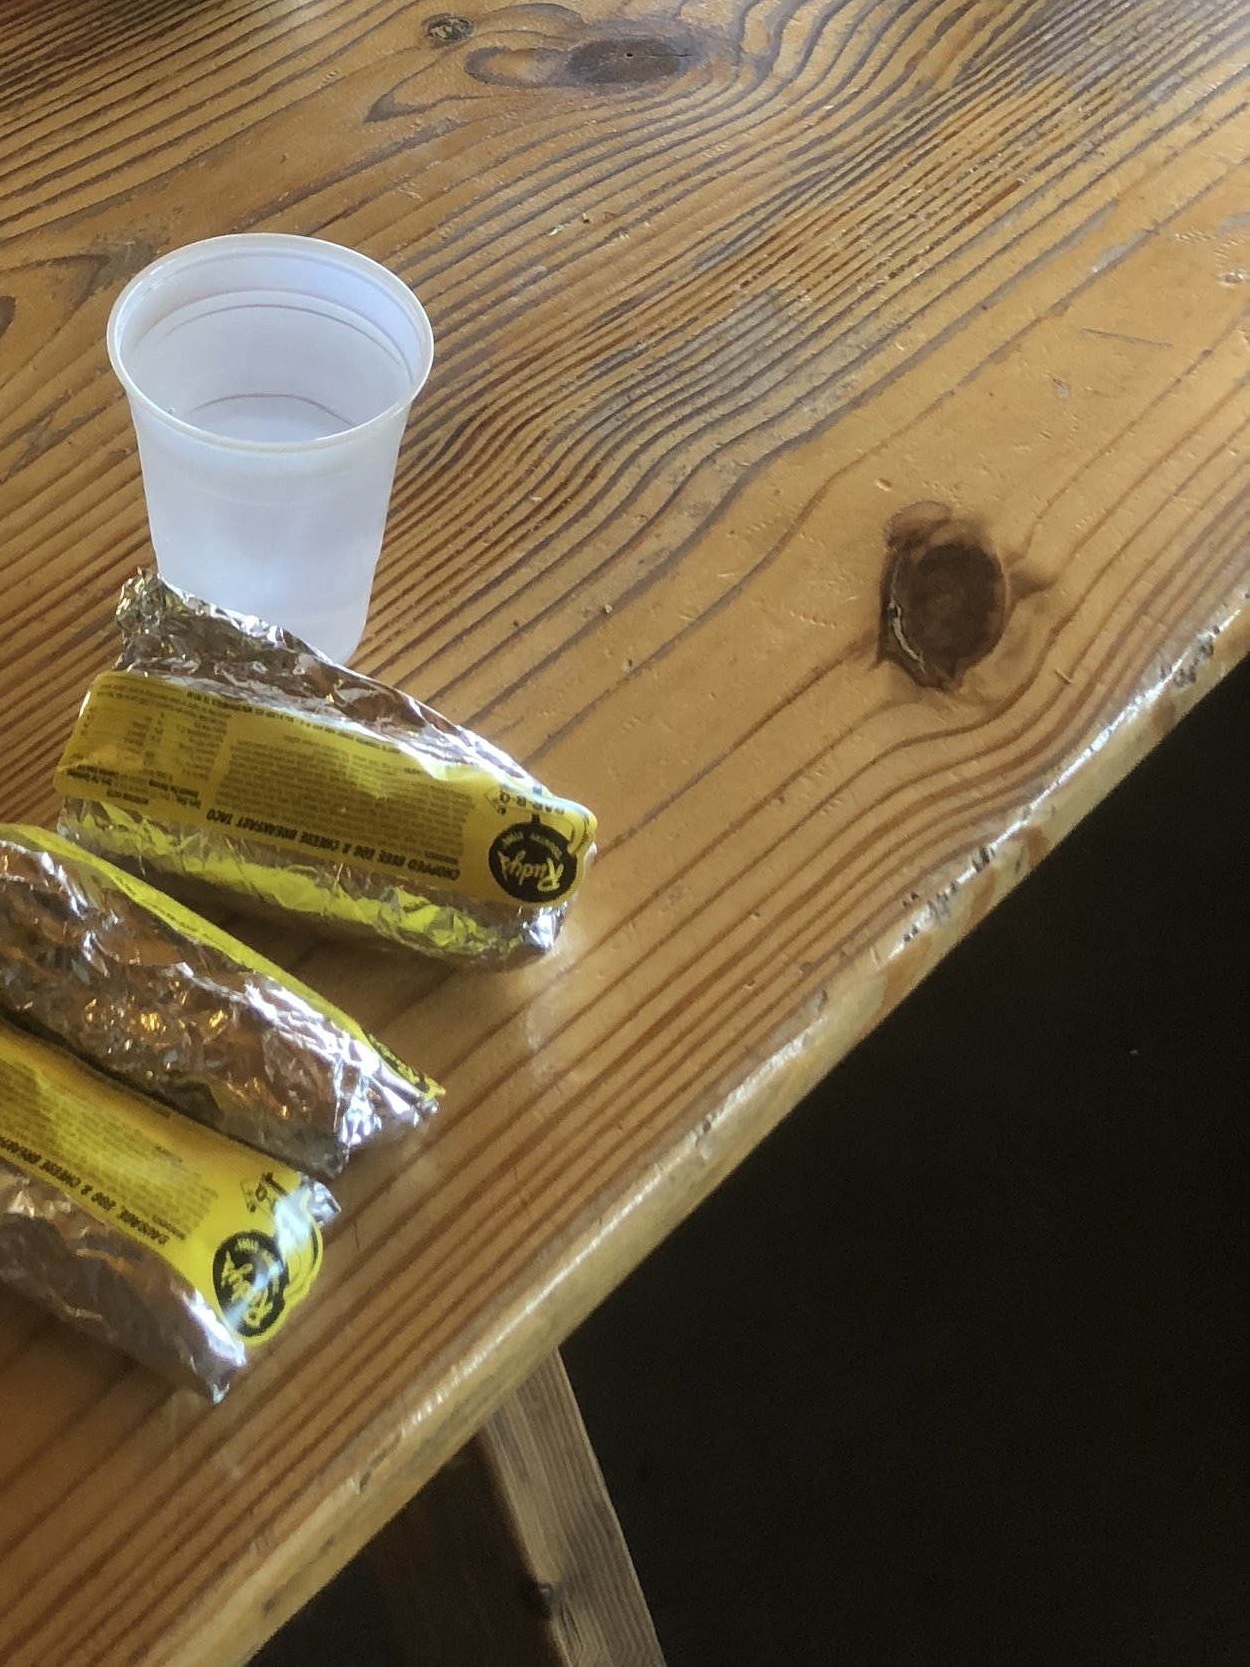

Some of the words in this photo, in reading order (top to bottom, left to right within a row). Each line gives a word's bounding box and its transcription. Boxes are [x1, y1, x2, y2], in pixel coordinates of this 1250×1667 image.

[206, 808, 233, 825] TACO
[235, 815, 298, 840] BREAKFAST
[407, 859, 461, 882] CHOPPED
[497, 850, 564, 892] Rudy's
